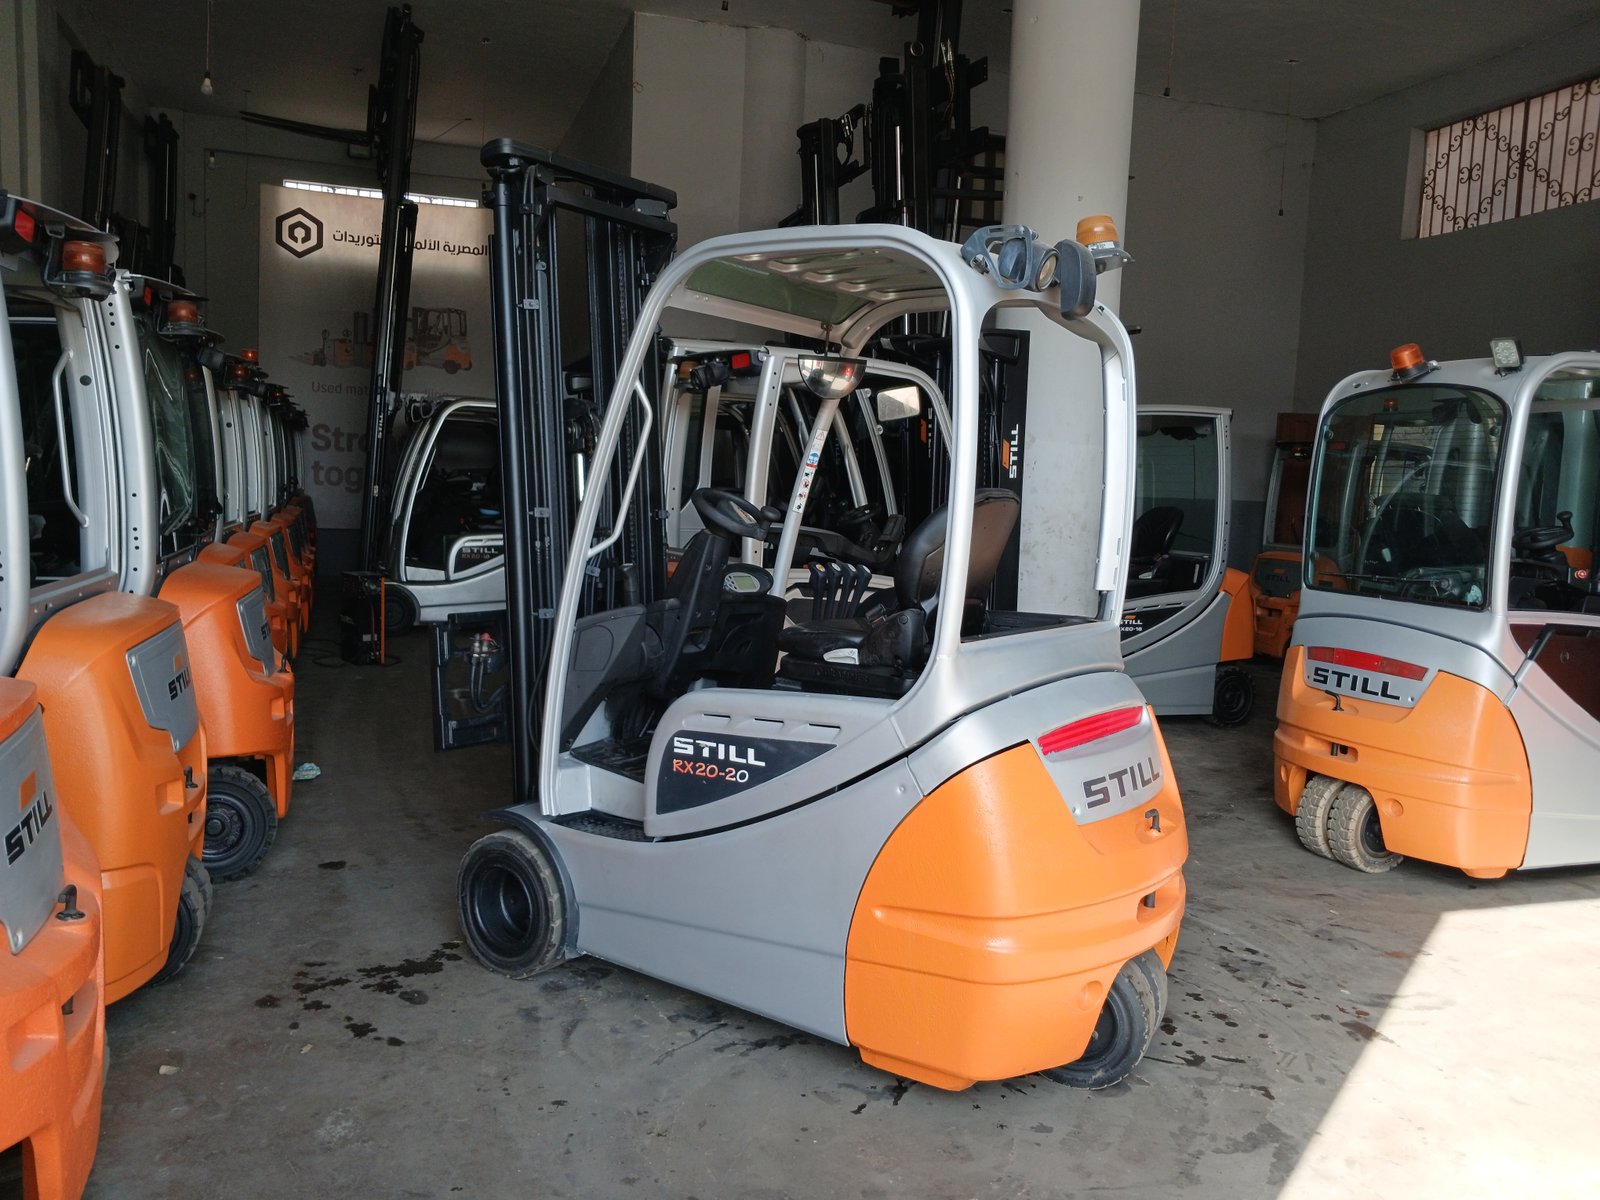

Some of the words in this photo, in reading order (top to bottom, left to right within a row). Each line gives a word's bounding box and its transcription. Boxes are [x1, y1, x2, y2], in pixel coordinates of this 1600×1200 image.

[443, 240, 488, 256] المصرية
[311, 381, 342, 394] Used
[1008, 423, 1019, 479] STILL
[1313, 666, 1400, 701] STILL
[673, 736, 766, 767] STILL
[672, 758, 749, 783] RX20-20
[1082, 757, 1160, 809] STILL
[5, 790, 53, 866] STILL
